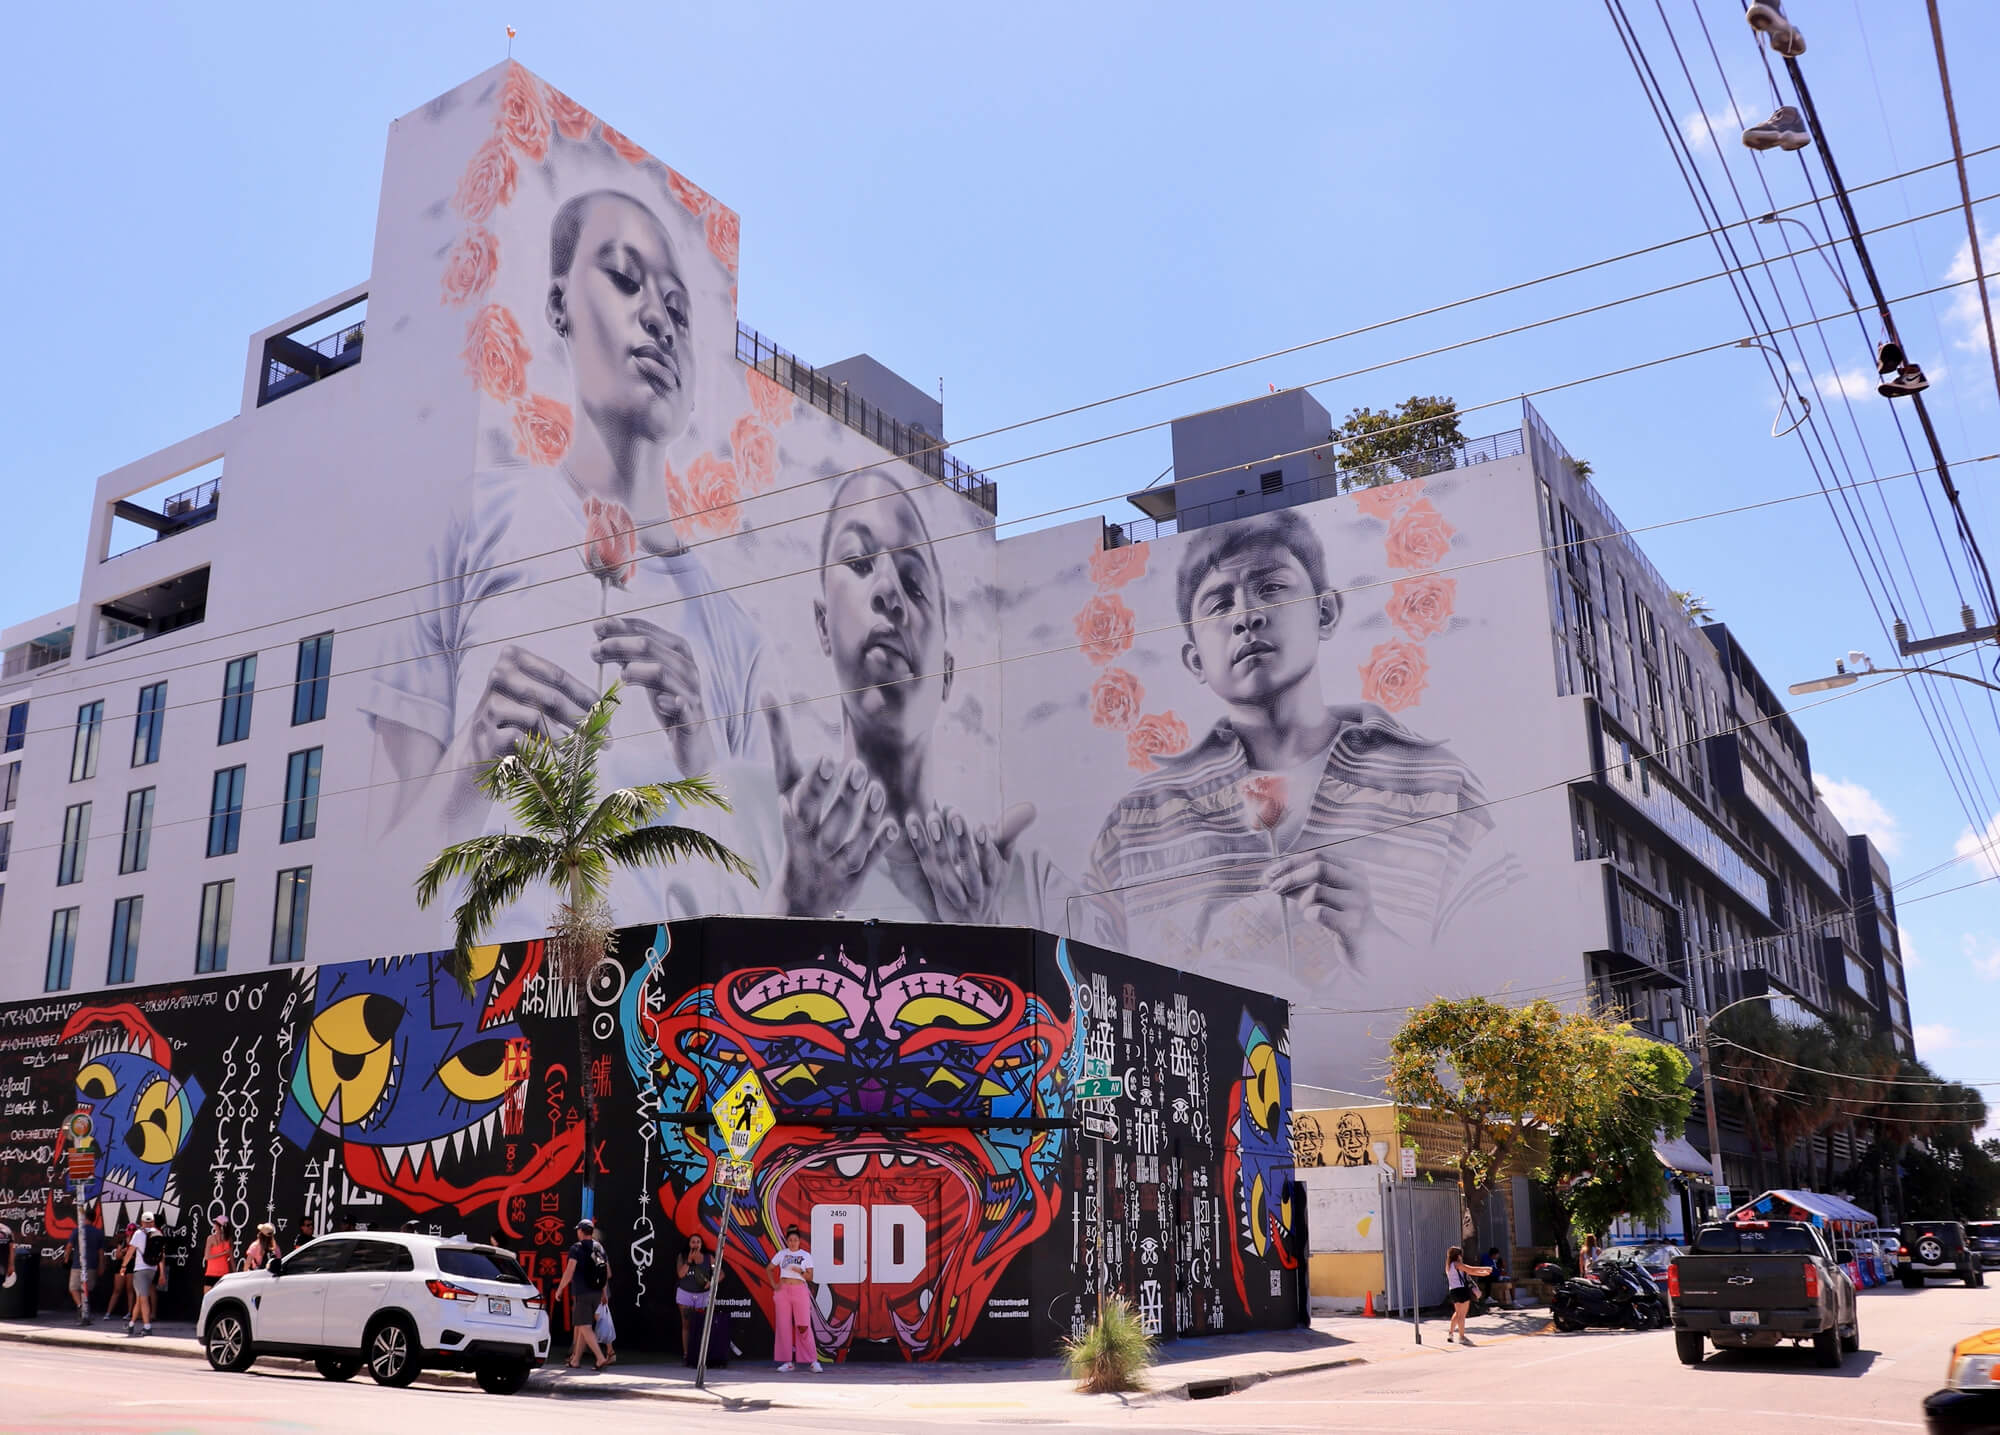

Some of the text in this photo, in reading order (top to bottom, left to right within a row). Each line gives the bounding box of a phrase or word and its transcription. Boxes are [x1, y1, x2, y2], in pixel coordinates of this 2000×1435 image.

[1096, 1061, 1105, 1077] 25
[1093, 1081, 1101, 1095] 2
[1111, 1082, 1120, 1093] AV
